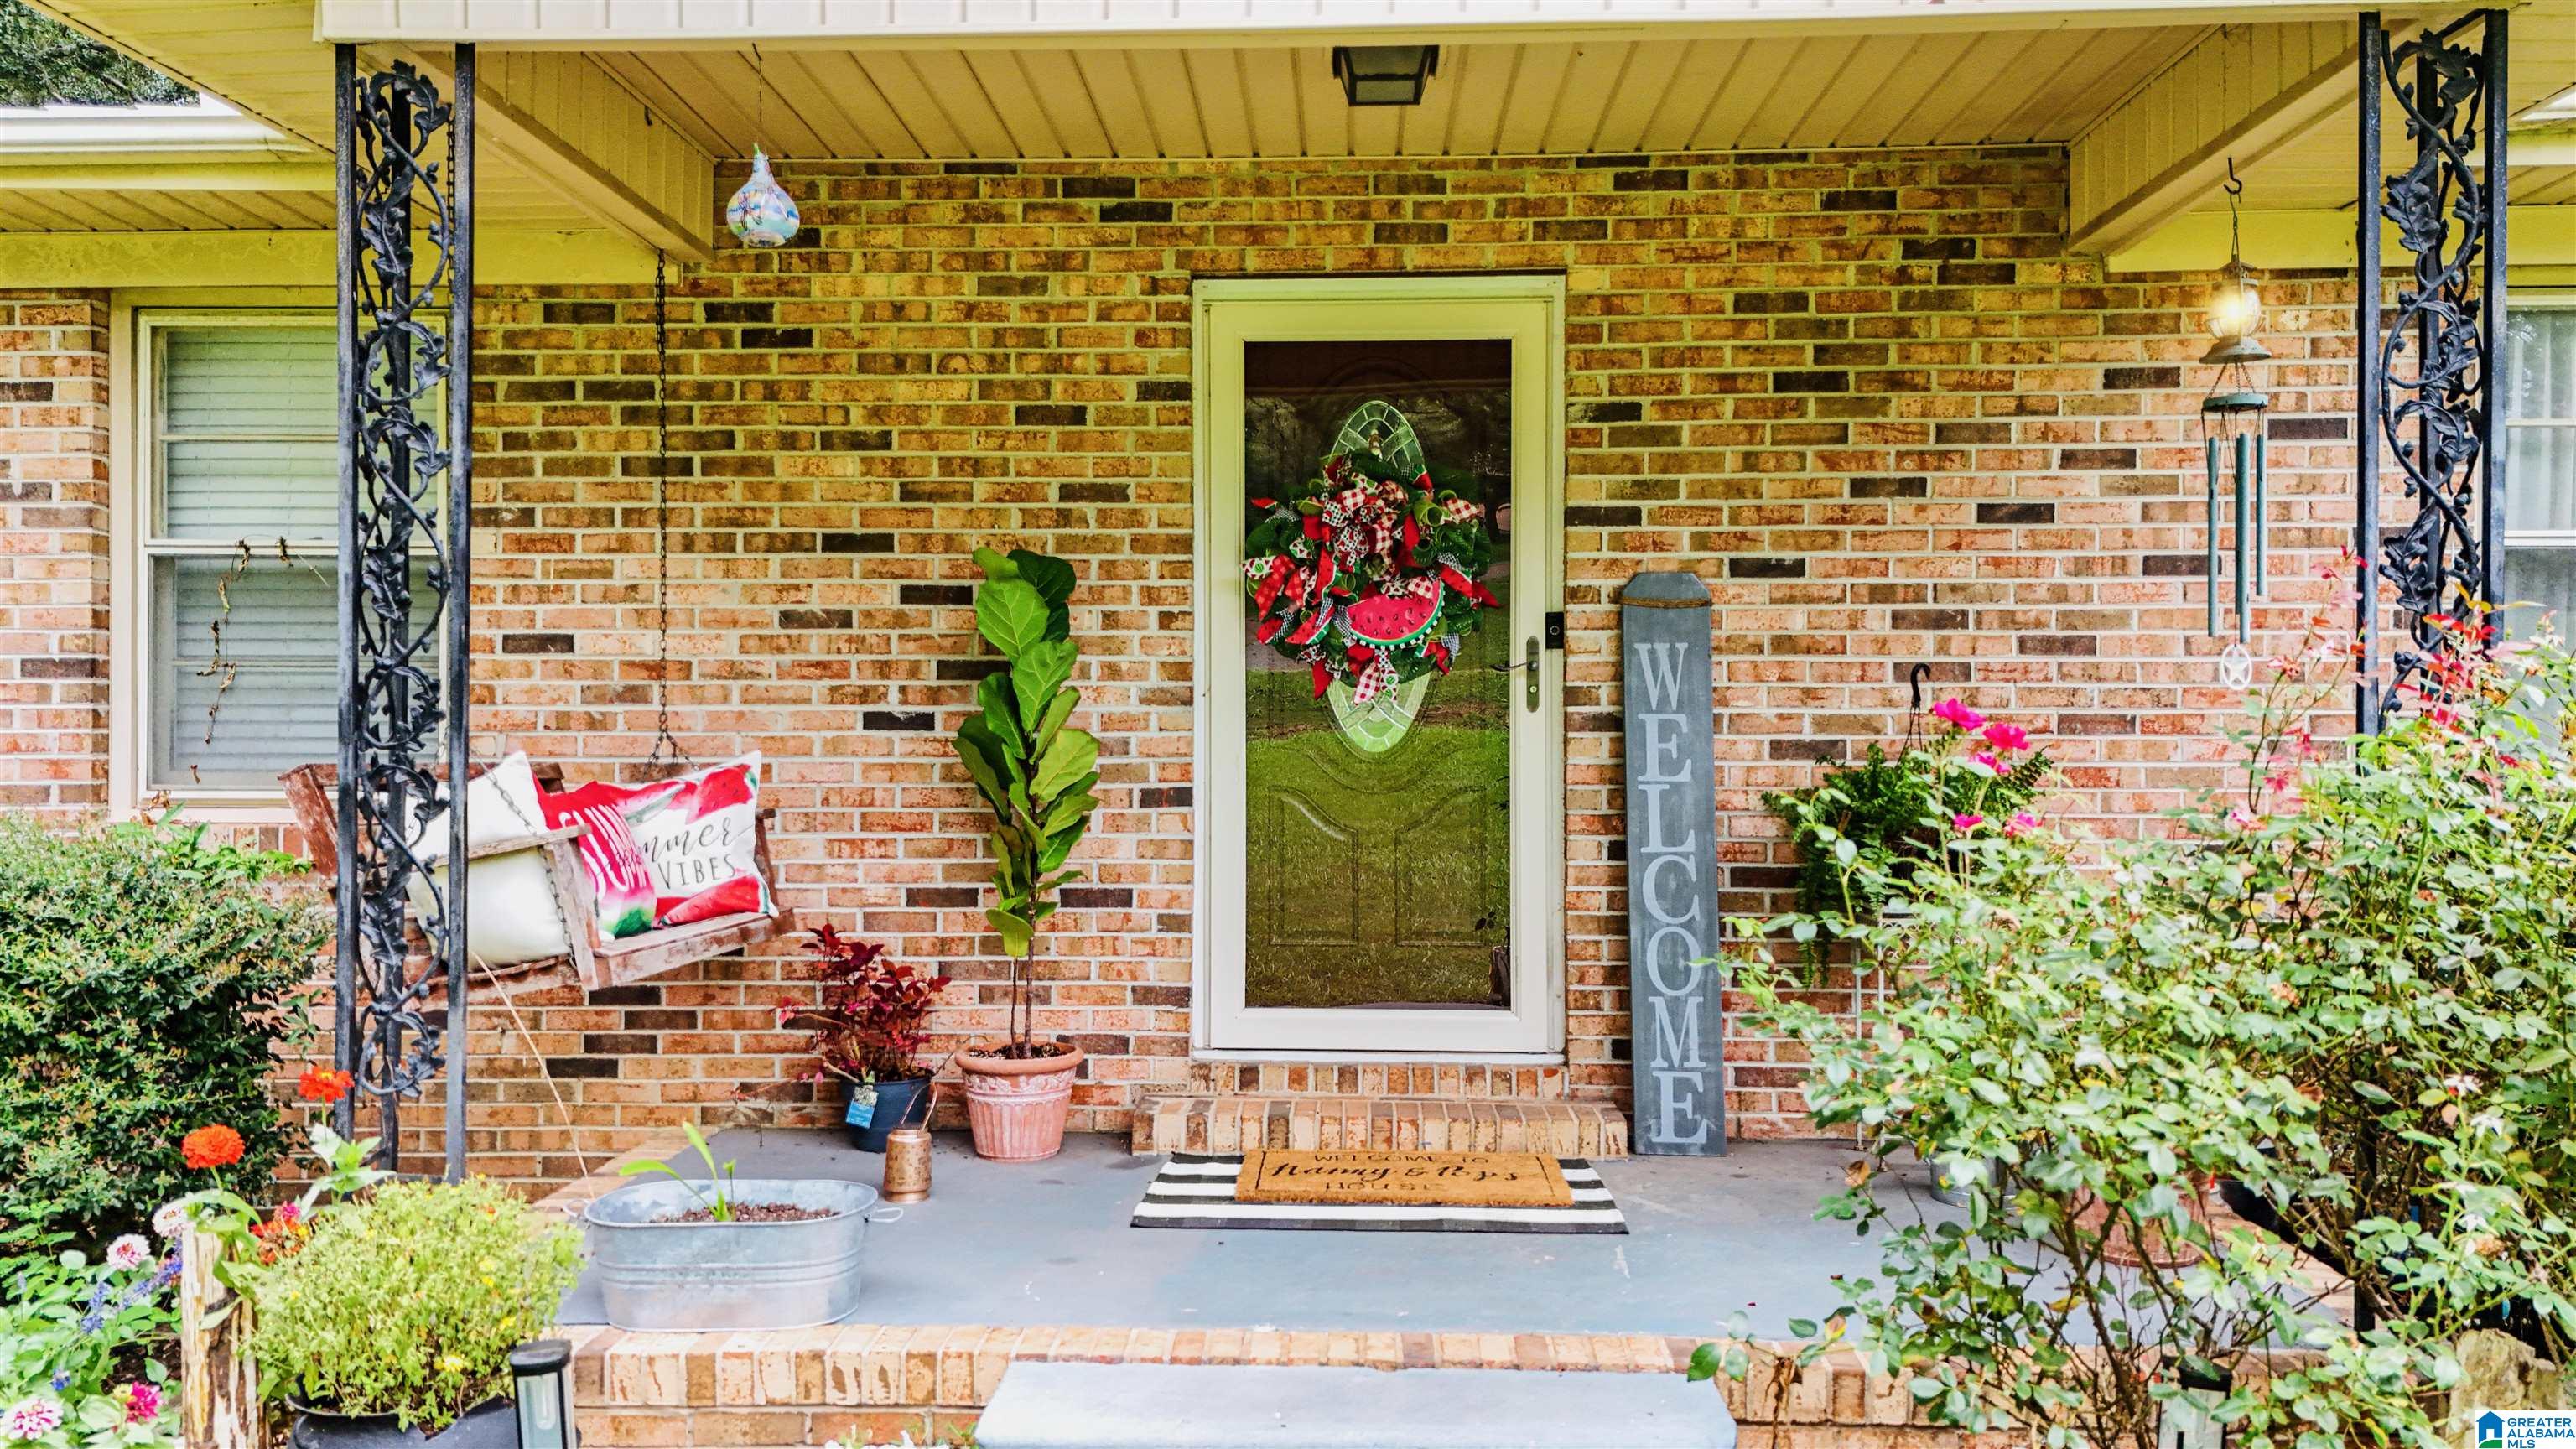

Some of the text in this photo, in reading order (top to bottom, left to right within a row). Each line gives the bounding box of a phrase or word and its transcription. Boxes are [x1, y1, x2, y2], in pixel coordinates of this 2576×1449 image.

[657, 853, 736, 889] VIBES
[1633, 641, 1708, 1145] WELCOME
[1314, 1153, 1436, 1163] WELCOME
[1325, 1182, 1445, 1191] HOUSE
